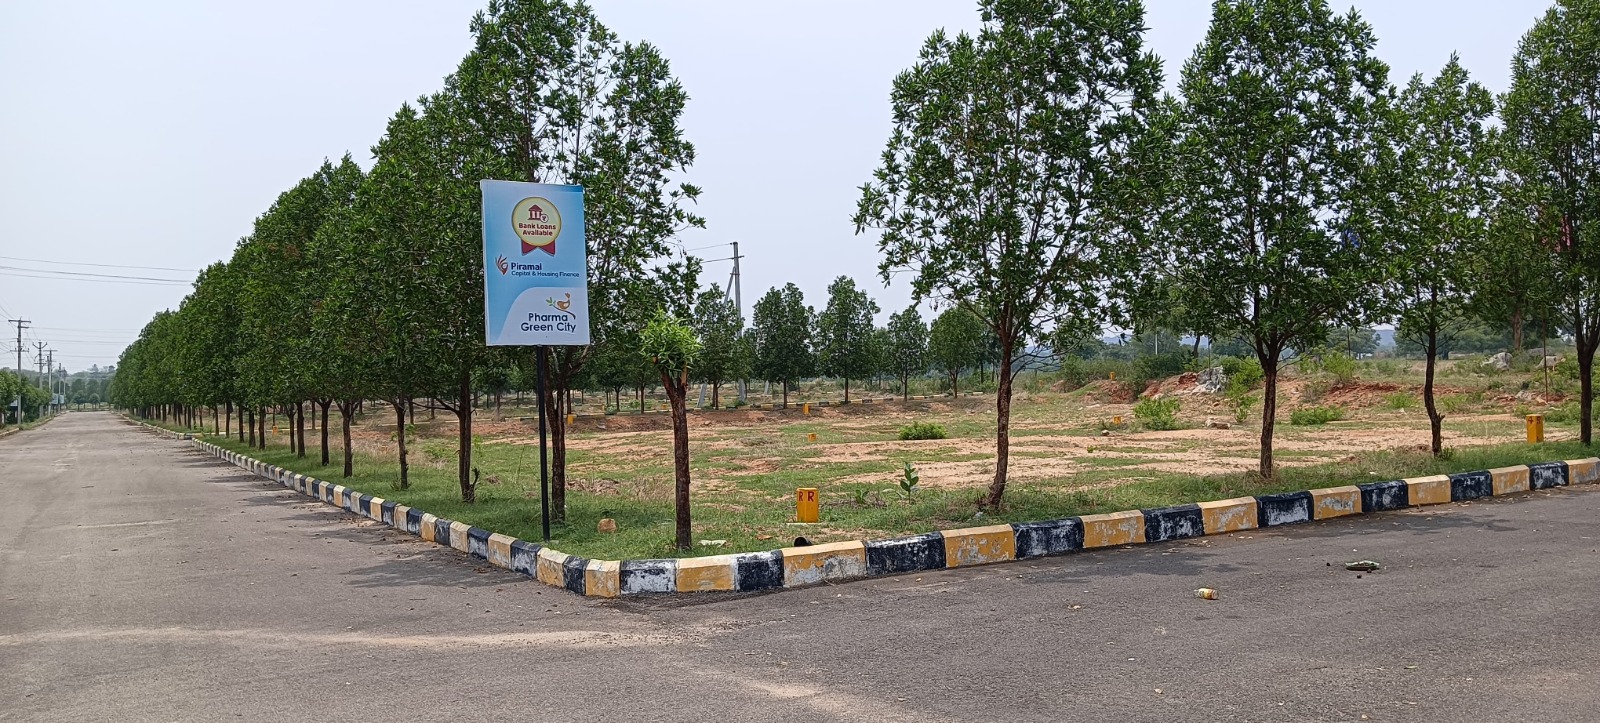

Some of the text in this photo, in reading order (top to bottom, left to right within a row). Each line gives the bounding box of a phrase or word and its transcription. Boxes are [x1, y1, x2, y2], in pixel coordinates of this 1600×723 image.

[511, 262, 542, 270] Piramal
[528, 312, 568, 322] Pharma
[520, 322, 576, 333] Green City
[799, 491, 803, 501] R
[808, 491, 814, 502] R
